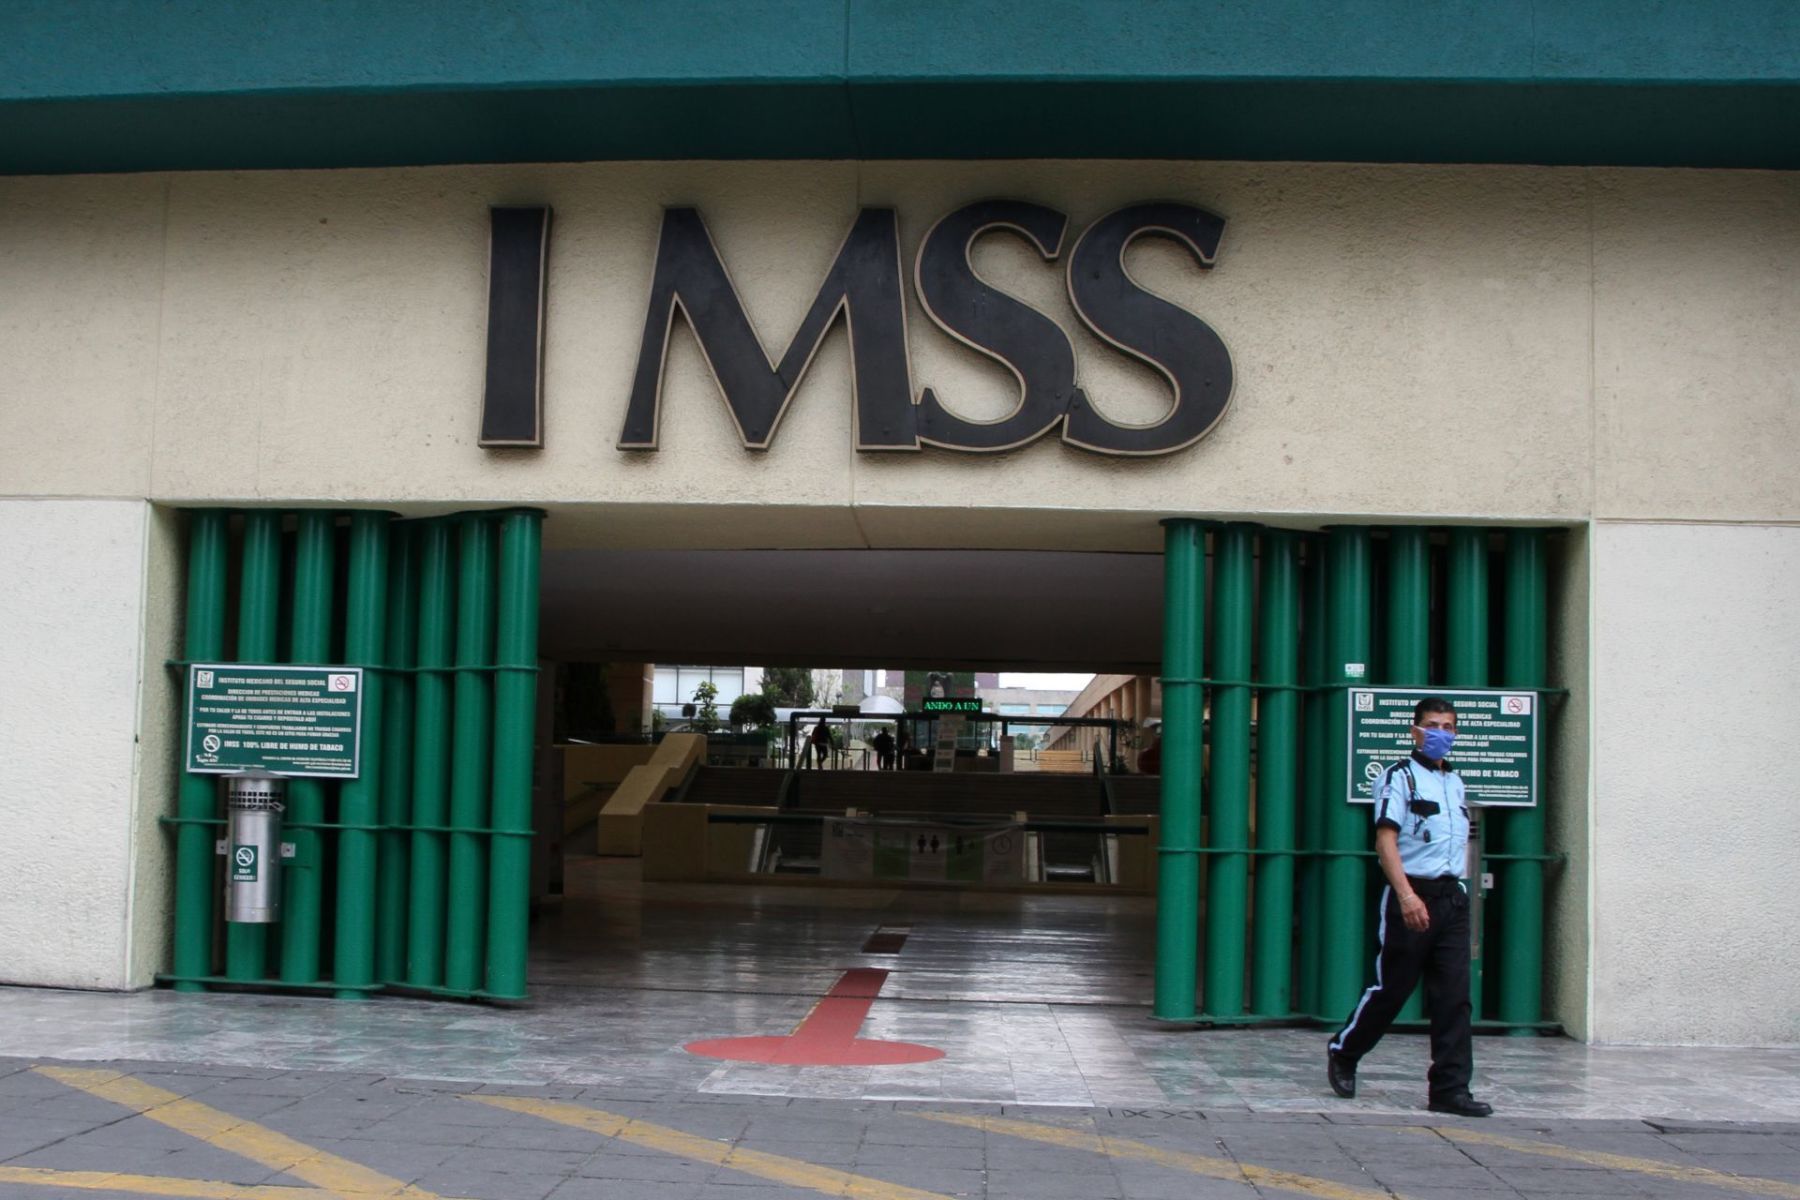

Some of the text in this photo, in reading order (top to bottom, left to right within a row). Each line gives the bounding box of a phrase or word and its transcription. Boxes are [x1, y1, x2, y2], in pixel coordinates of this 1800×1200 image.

[477, 198, 1236, 457] IMSS
[924, 701, 979, 710] ANDO A UN
